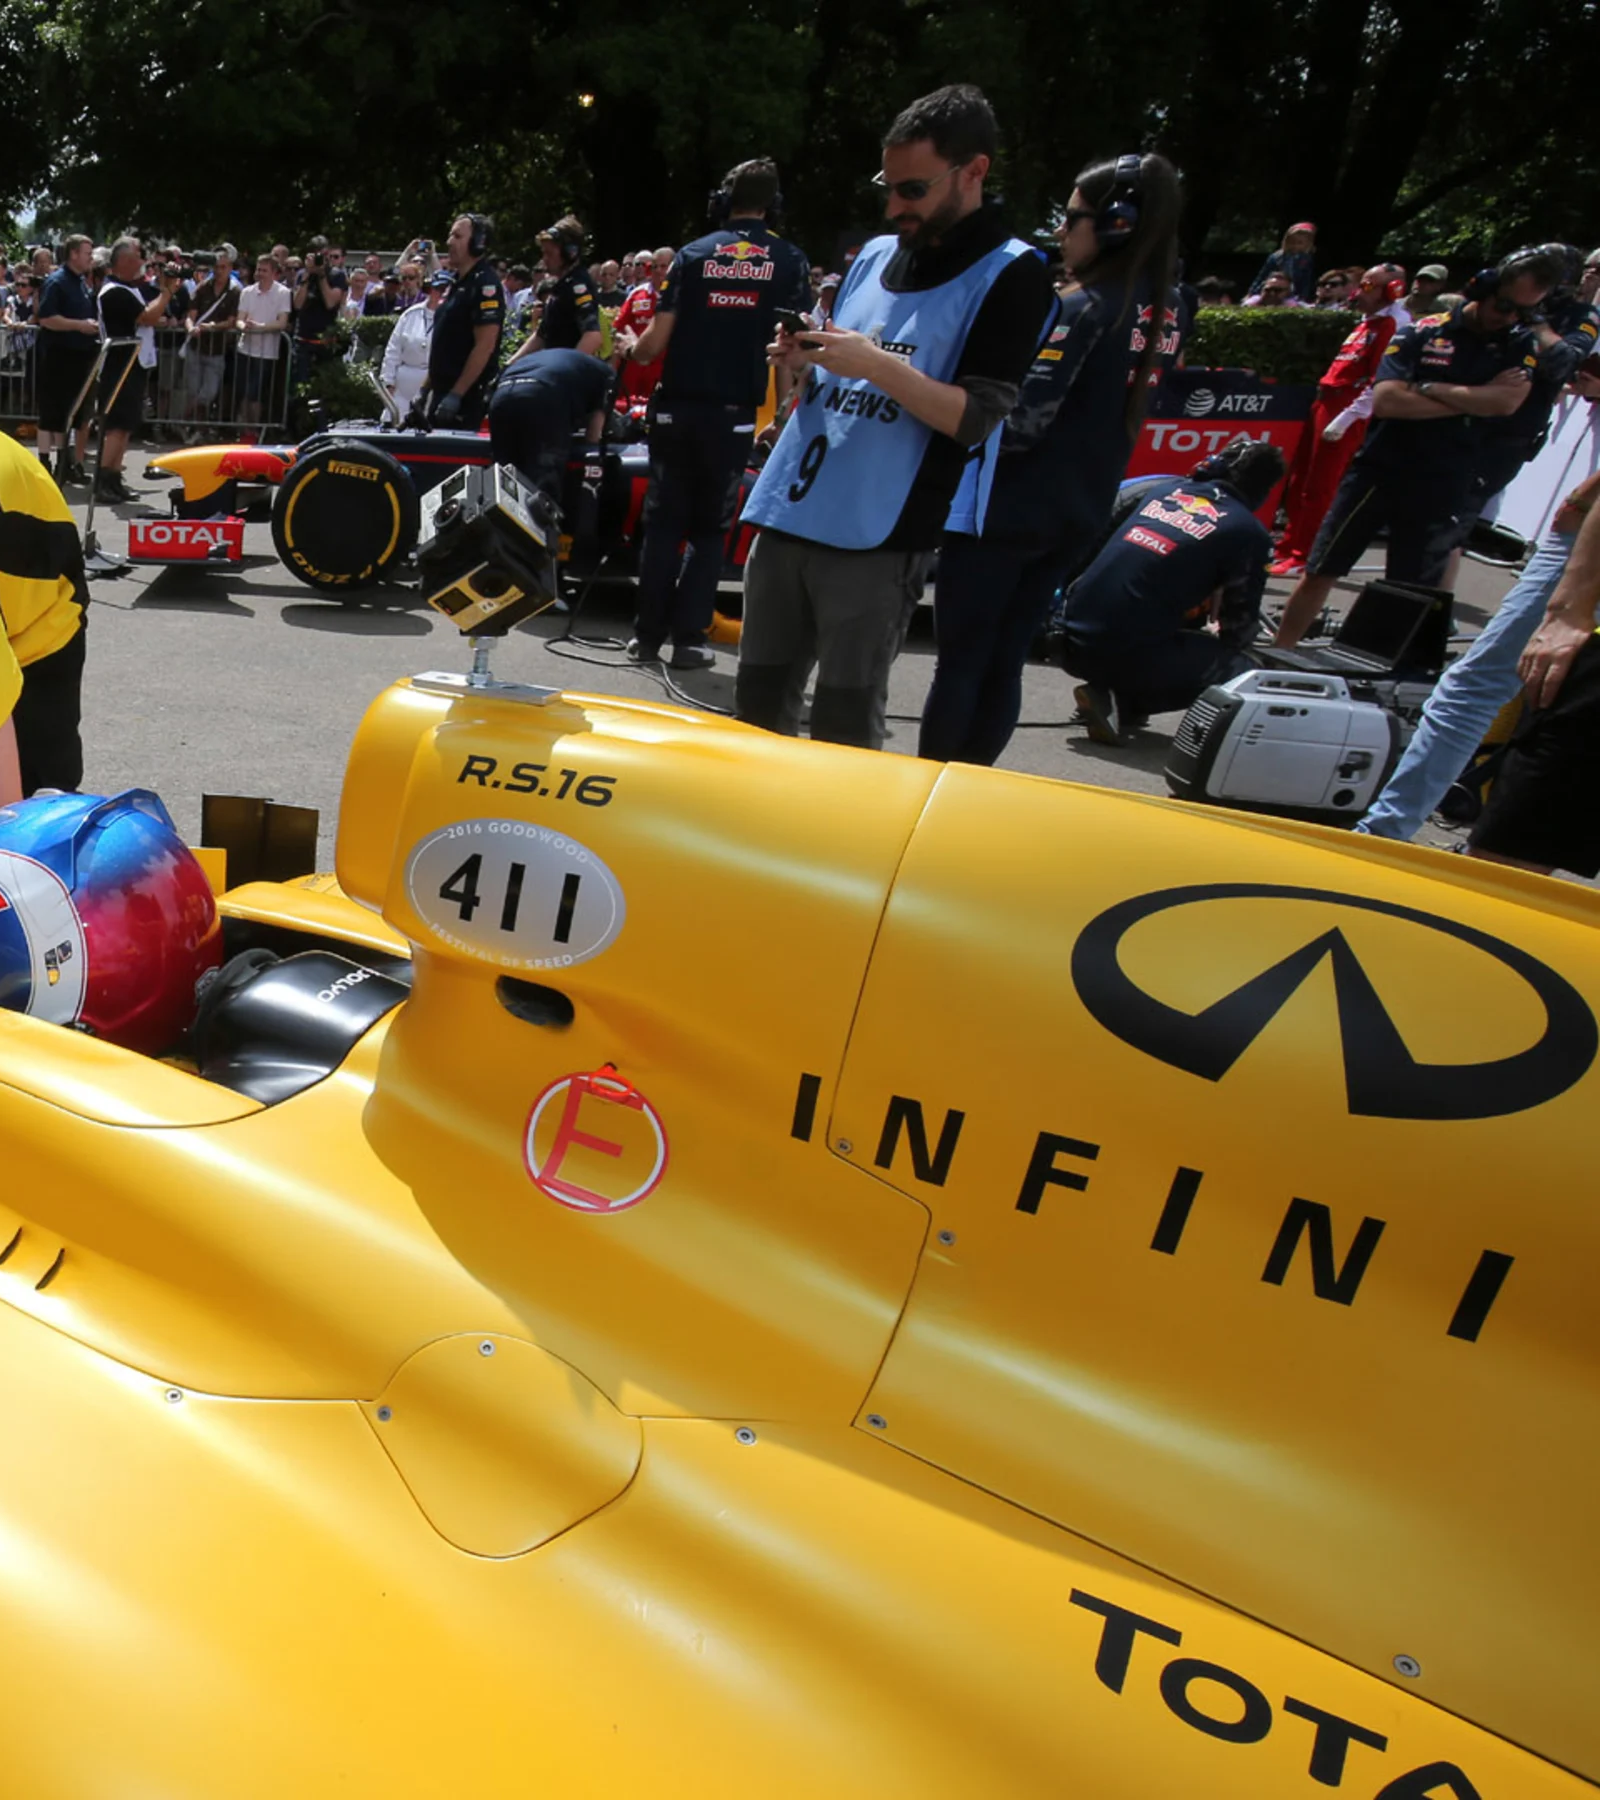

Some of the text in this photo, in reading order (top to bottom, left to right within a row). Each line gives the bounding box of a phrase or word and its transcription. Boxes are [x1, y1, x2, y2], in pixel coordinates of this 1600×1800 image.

[703, 259, 774, 281] Red Bull
[709, 292, 756, 306] TOTAL
[824, 386, 900, 424] NEWS
[1217, 394, 1273, 412] AT&T
[327, 460, 380, 481] PIRELLI
[788, 434, 828, 502] 9
[130, 521, 234, 546] TOTAL
[1139, 499, 1217, 541] Red Bull
[1128, 527, 1168, 554] TOTAL
[292, 551, 352, 584] ZERO
[456, 754, 617, 807] R.S.16
[447, 821, 590, 864] 2016 GOODWOOD
[439, 853, 581, 943] 411
[430, 922, 574, 969] FESTIVAL OF SPEED
